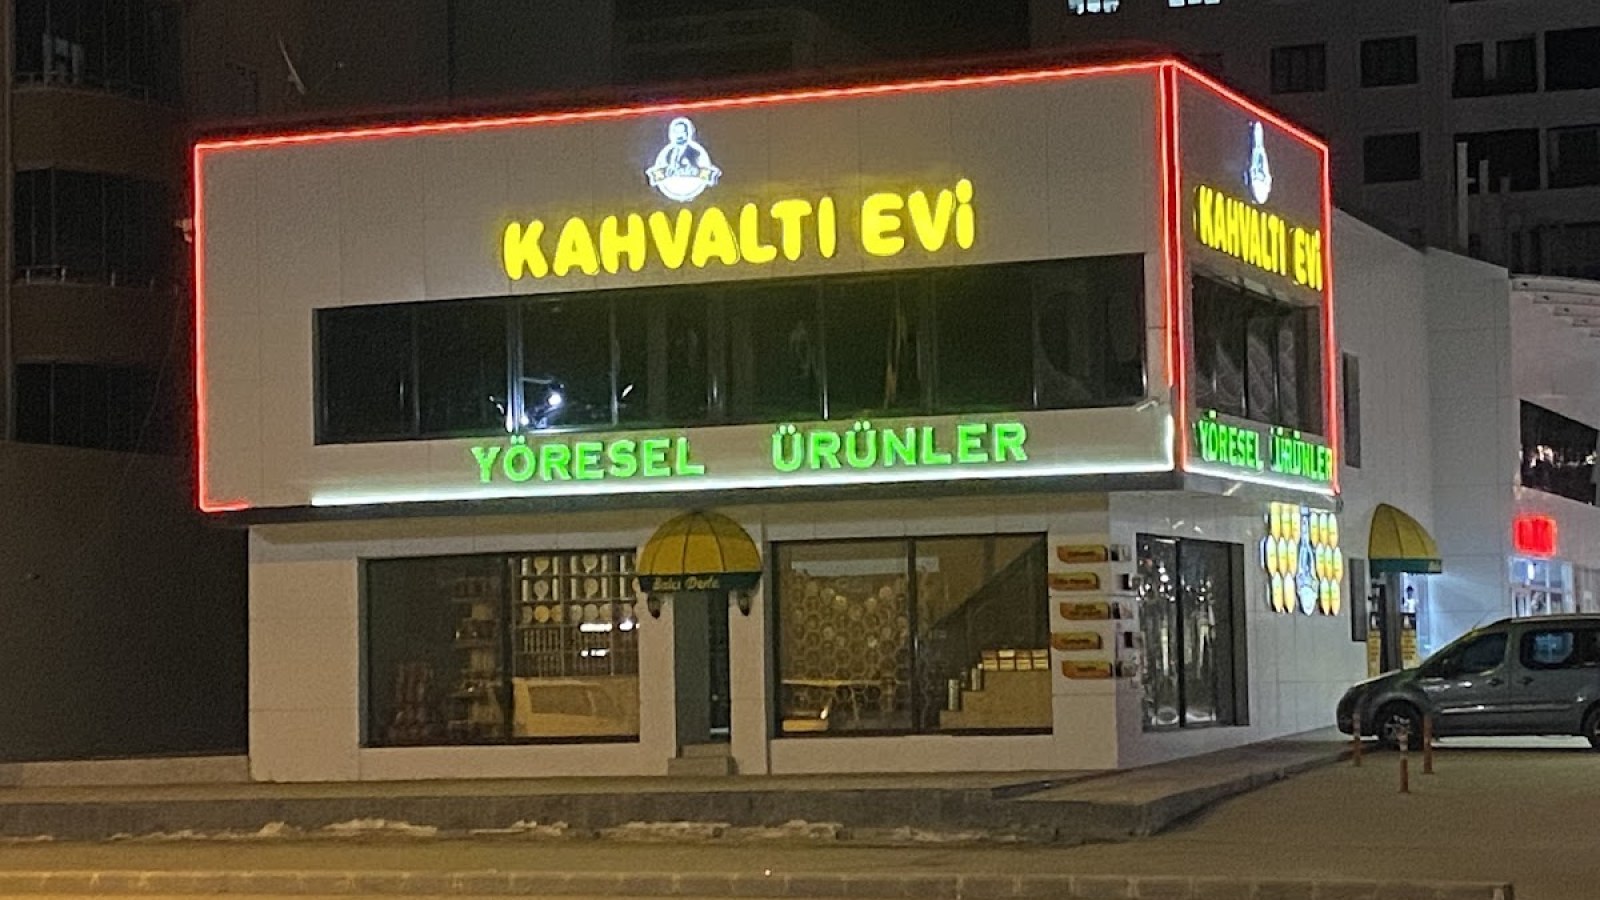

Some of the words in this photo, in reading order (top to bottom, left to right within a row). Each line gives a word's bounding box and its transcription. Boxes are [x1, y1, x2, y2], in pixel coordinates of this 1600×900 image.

[502, 195, 838, 281] KAHVALTI
[1199, 184, 1287, 277] KAHVALTI
[471, 434, 706, 482] YÖRESEL
[771, 420, 1028, 472] ÜRÜNLER
[1198, 409, 1265, 472] YÖRESEL
[1269, 426, 1333, 482] ÜRÜNLER
